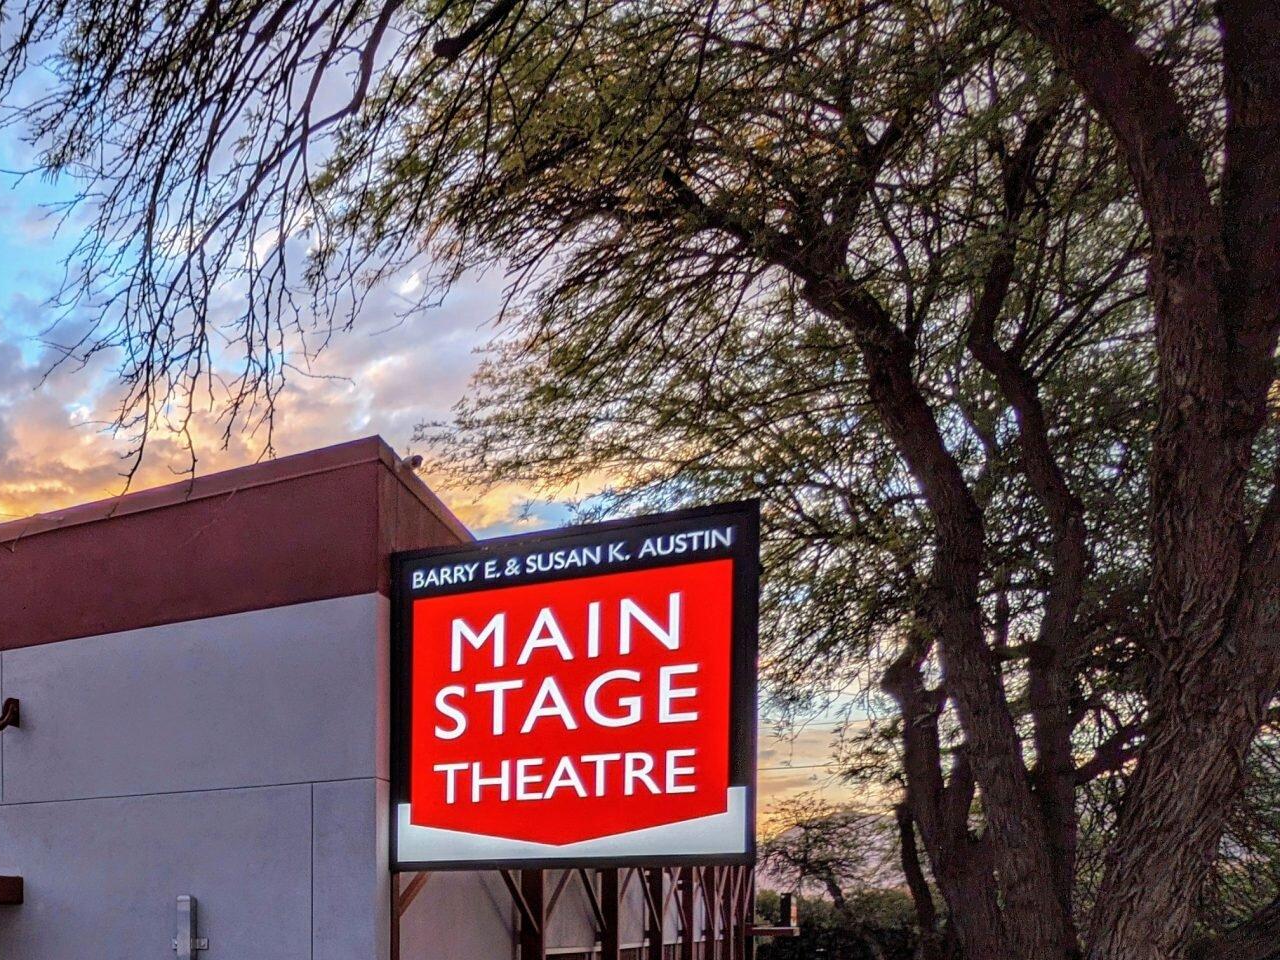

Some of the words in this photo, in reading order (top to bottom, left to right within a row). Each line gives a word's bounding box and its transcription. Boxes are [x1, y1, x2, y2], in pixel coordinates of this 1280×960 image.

[412, 563, 480, 590] BARRY
[484, 560, 502, 581] E.
[505, 557, 521, 576] &
[526, 546, 601, 574] SUSAN
[608, 541, 630, 564] K.
[638, 526, 733, 559] AUSTIN
[449, 591, 682, 673] MAIN
[433, 662, 700, 741] STAGE
[432, 747, 697, 804] THEATRE
